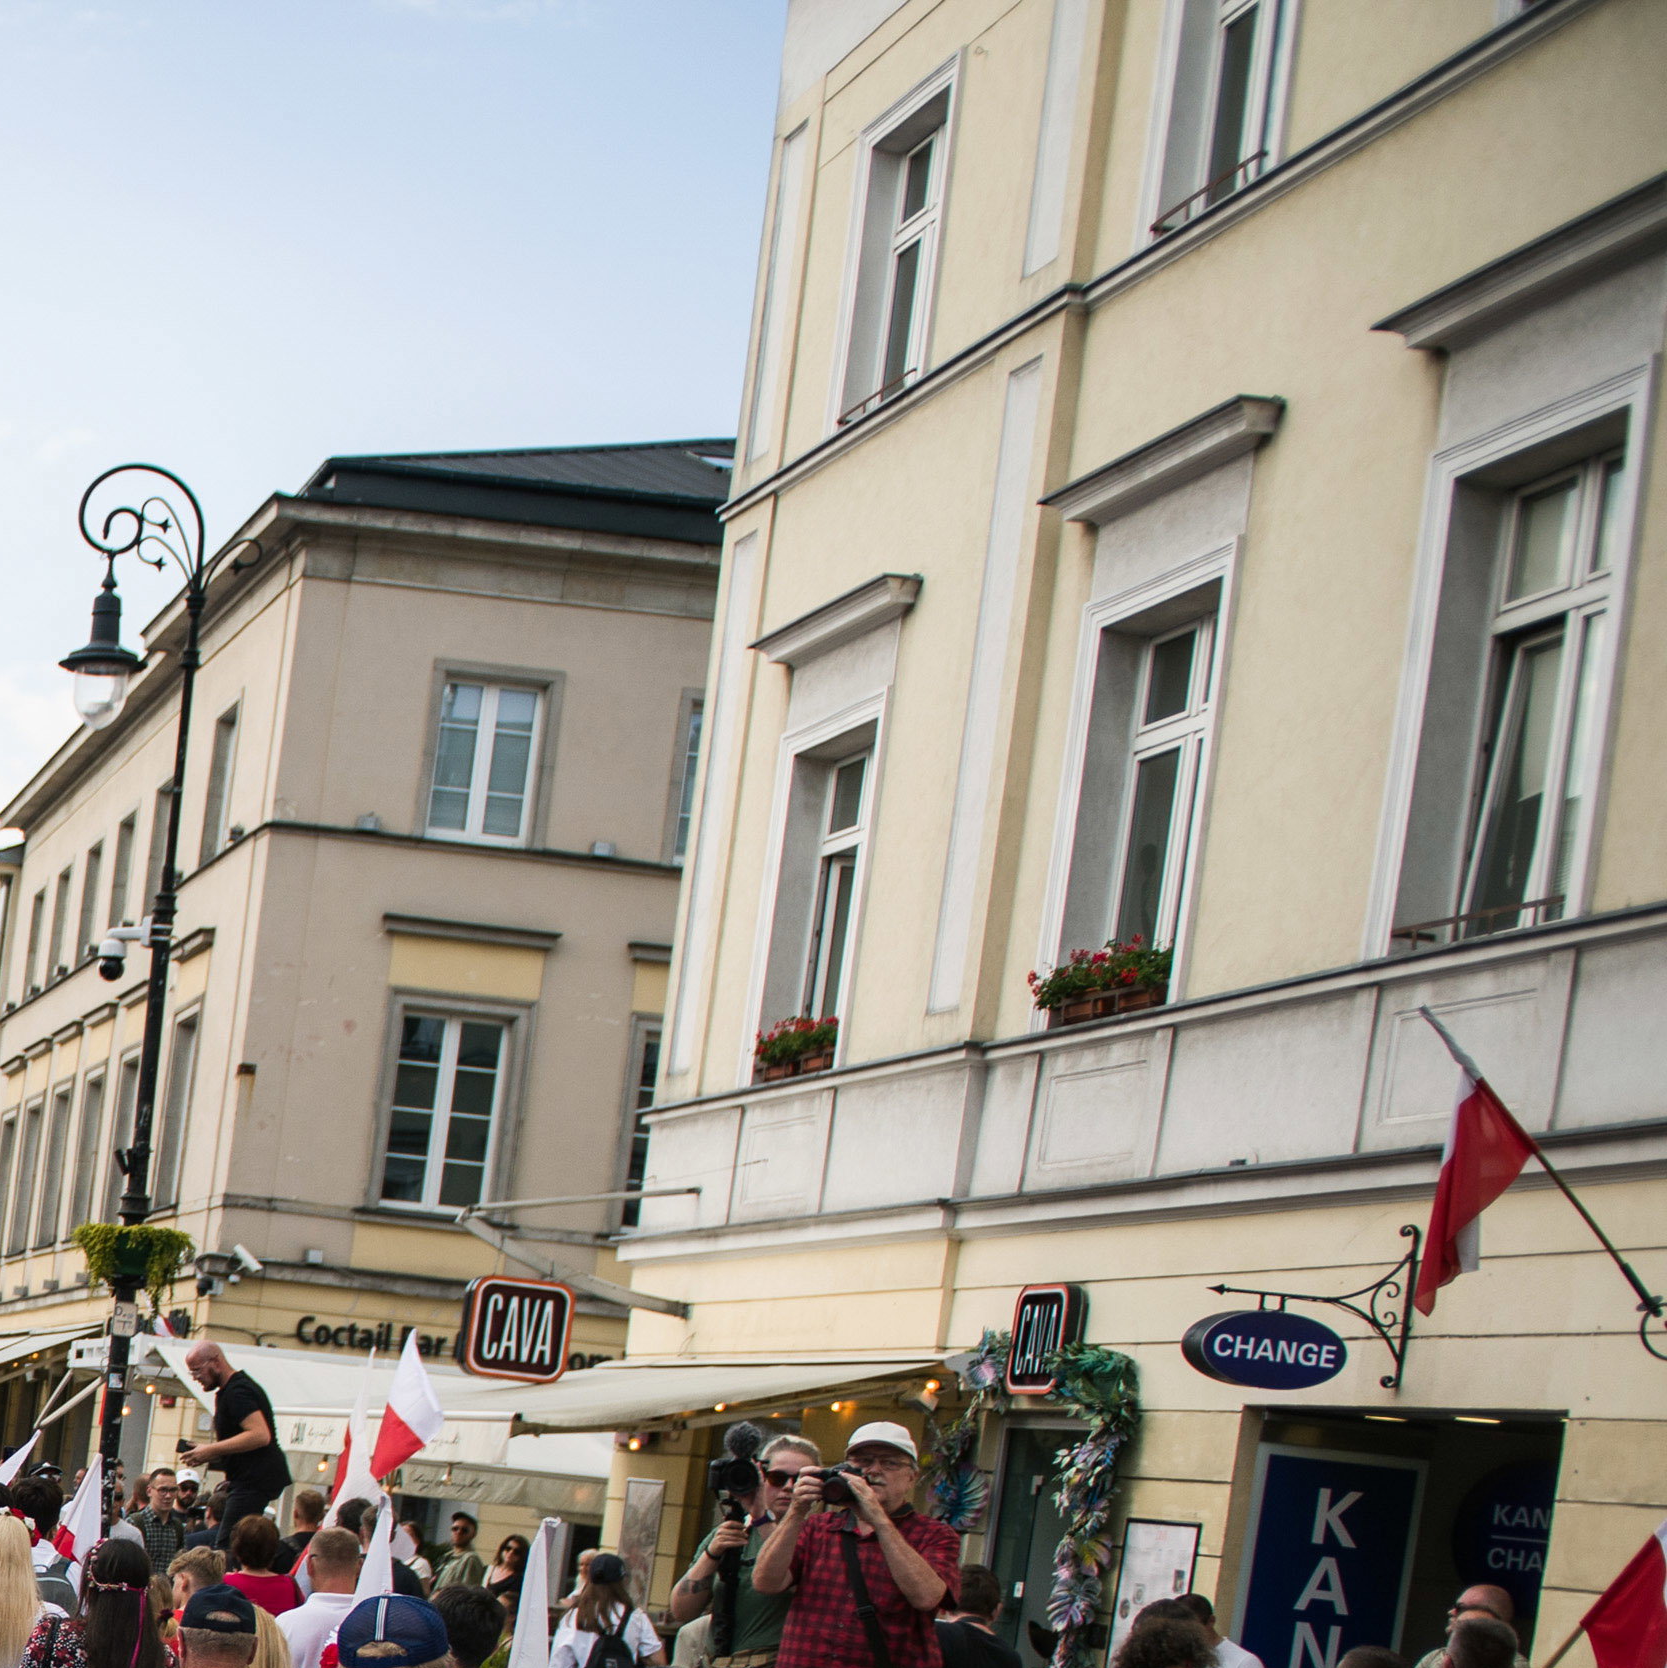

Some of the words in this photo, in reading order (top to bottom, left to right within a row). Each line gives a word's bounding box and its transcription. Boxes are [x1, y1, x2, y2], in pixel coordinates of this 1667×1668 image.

[296, 1315, 393, 1350] Coctail
[482, 1293, 555, 1366] CAVA
[1213, 1333, 1338, 1369] CHANGE
